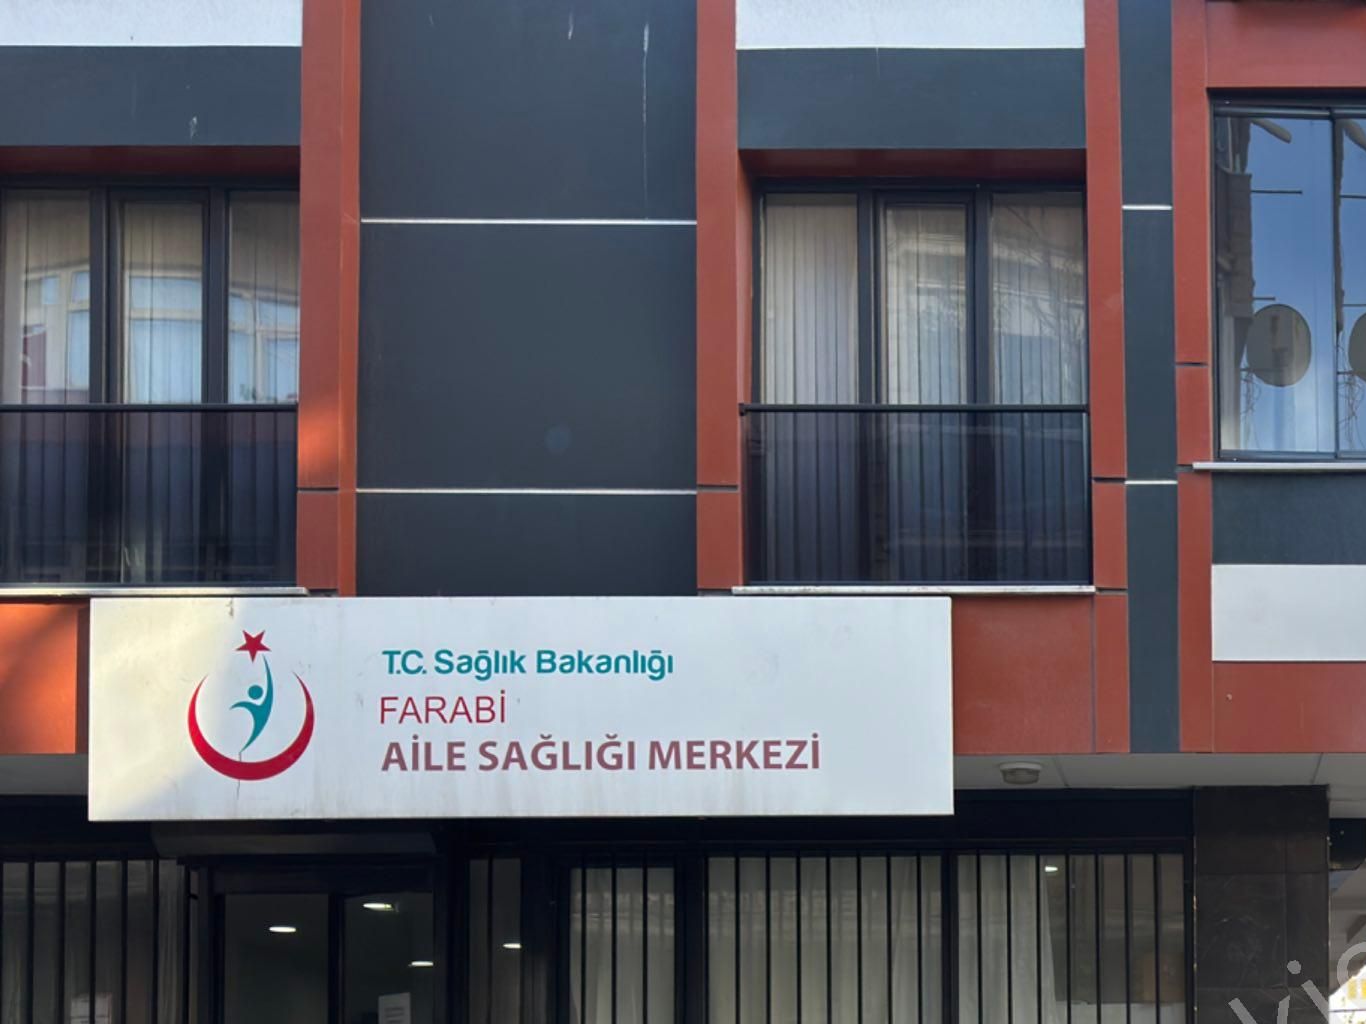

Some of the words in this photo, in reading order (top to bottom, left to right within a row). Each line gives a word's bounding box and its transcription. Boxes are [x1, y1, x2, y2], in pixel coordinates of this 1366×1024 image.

[382, 649, 429, 676] T.C.
[434, 648, 527, 681] Sağlık
[536, 648, 675, 681] Bakanlığı
[380, 689, 507, 724] FARABİ
[381, 734, 466, 773] AİLE
[478, 733, 638, 773] SAĞLIĞI
[649, 731, 820, 772] MERKEZİ
